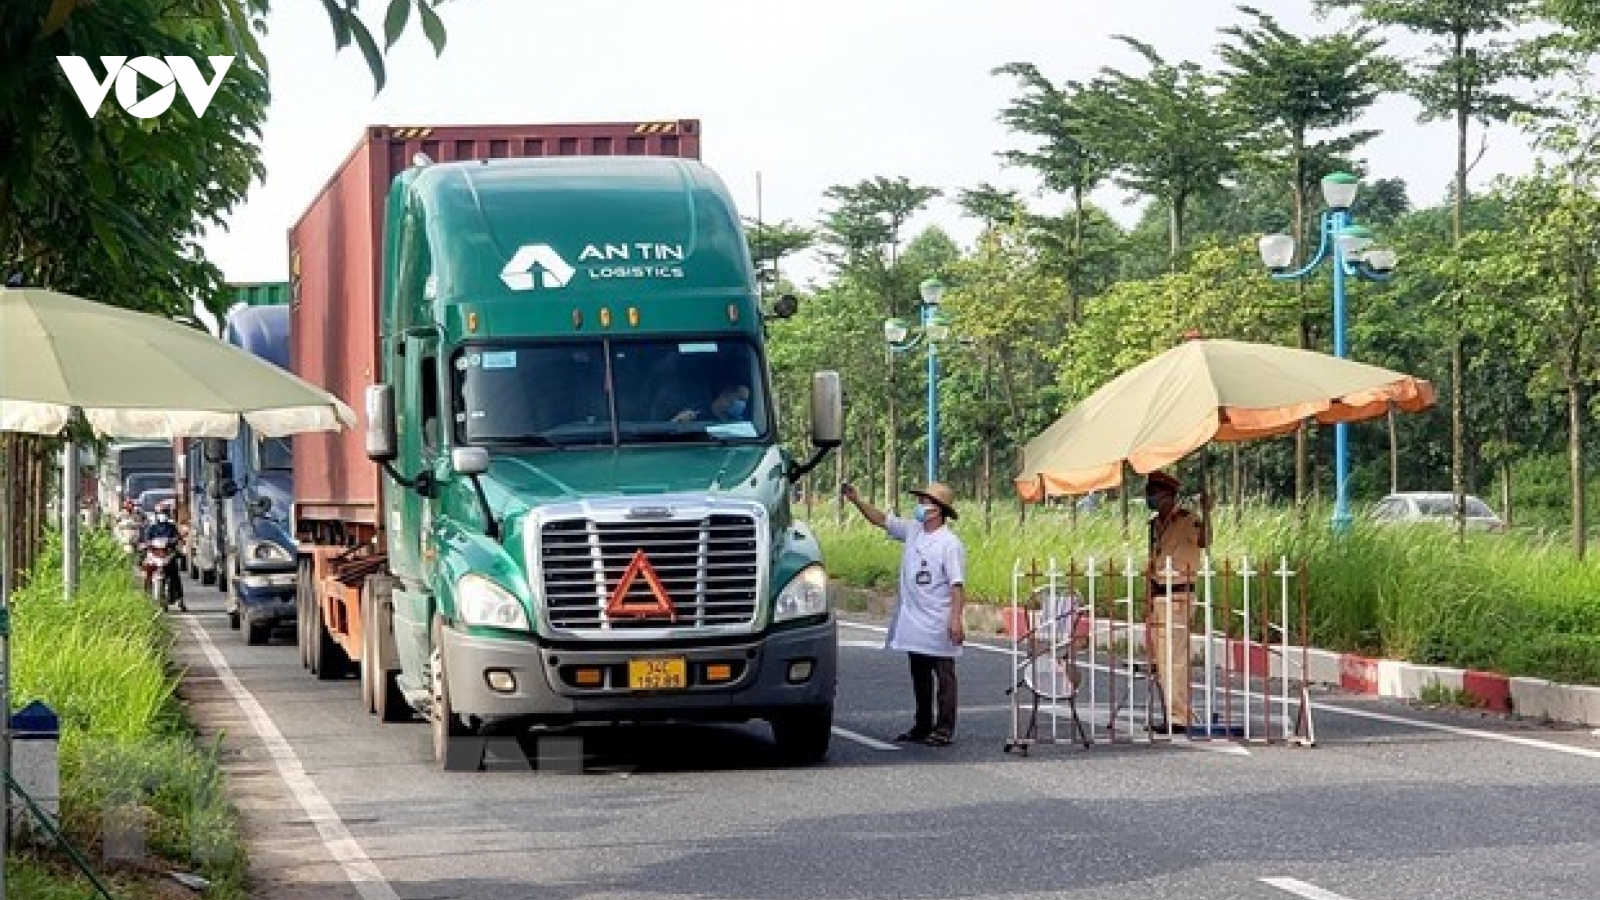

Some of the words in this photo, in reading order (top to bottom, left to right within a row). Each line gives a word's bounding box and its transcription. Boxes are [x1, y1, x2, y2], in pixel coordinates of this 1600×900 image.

[578, 243, 630, 261] AN
[635, 243, 685, 260] TIN
[589, 266, 684, 278] LOGISTICS
